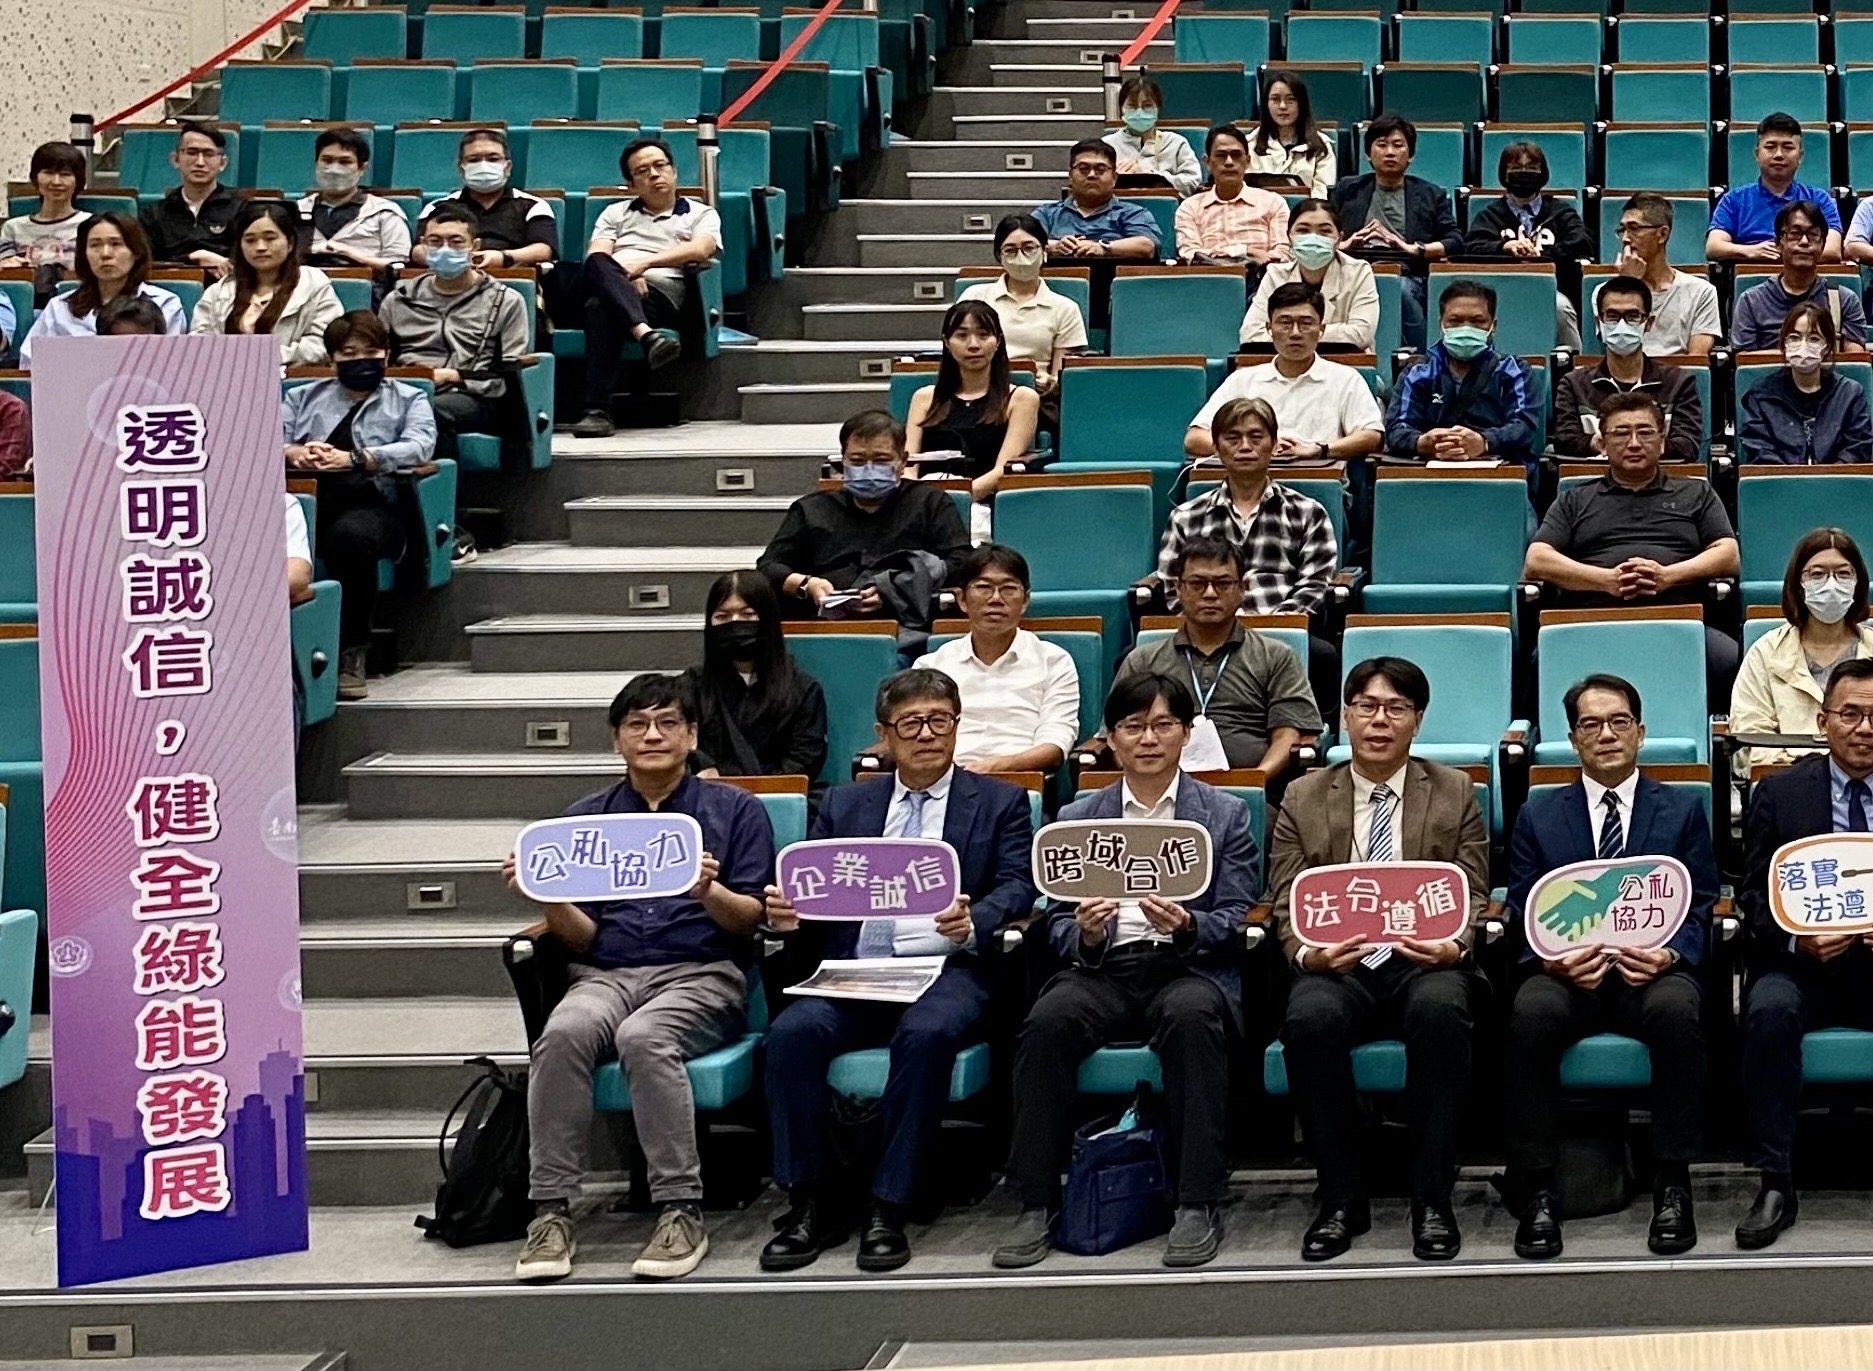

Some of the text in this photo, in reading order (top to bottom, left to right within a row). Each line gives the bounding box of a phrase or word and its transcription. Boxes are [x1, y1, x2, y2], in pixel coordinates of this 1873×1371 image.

[119, 406, 228, 1214] 透明誠信，健全綠能發展
[529, 830, 688, 888] 公私協力
[788, 851, 947, 910] 企業誠信
[1043, 831, 1199, 892] 跨域合作
[1619, 873, 1674, 902] 公私
[1778, 858, 1839, 891] 落實
[1302, 875, 1457, 937] 法令遵循
[1611, 904, 1665, 932] 協力
[1803, 889, 1868, 923] 法遵
